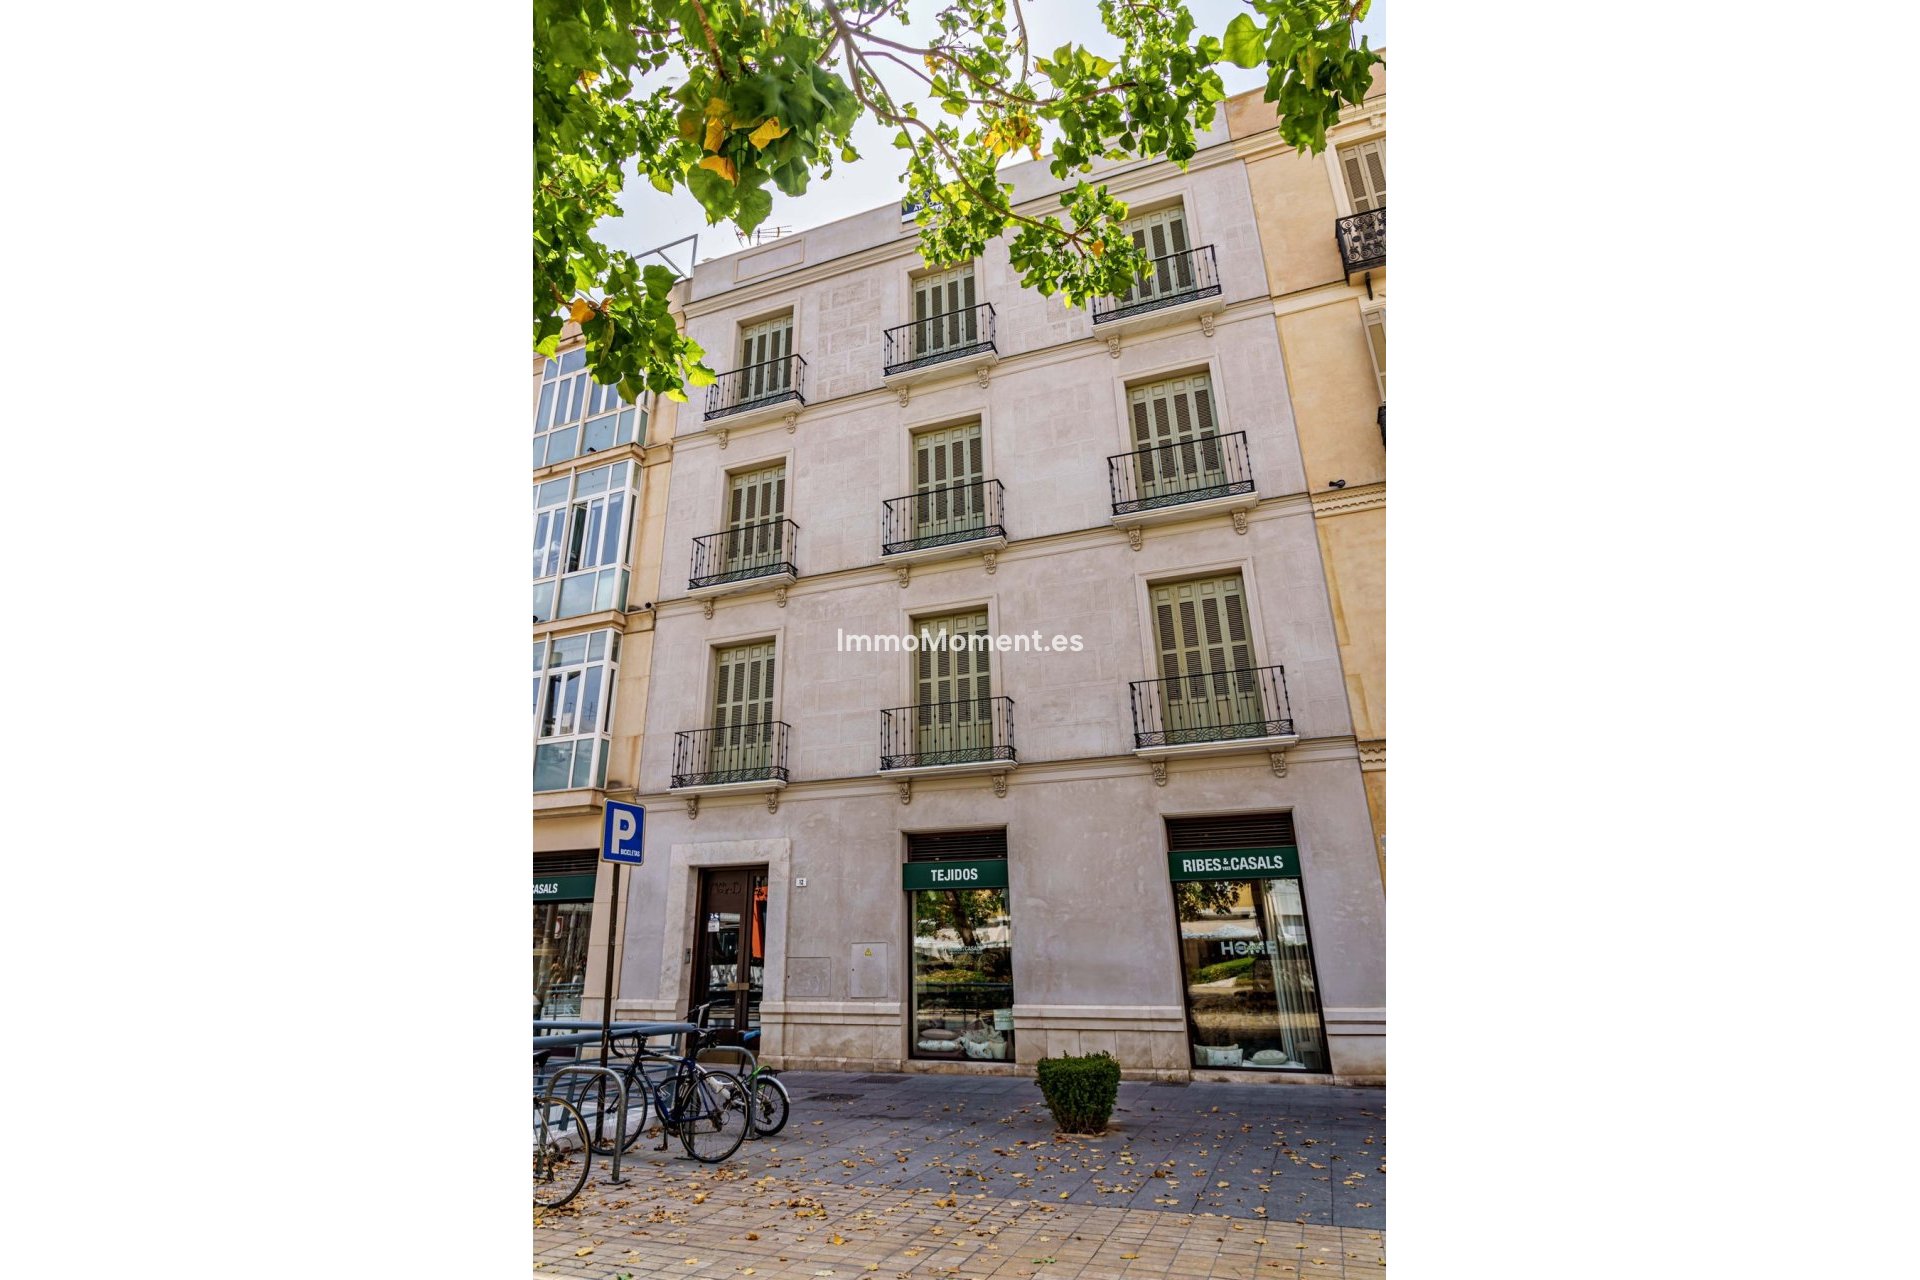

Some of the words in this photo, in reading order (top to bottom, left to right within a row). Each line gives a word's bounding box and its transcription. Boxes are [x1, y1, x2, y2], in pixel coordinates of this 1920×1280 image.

[611, 808, 636, 854] P
[1182, 858, 1222, 872] RIBES
[1222, 857, 1229, 865] &
[1230, 855, 1284, 870] CASALS
[930, 868, 978, 882] TEJIDOS
[1220, 940, 1277, 955] HOME
